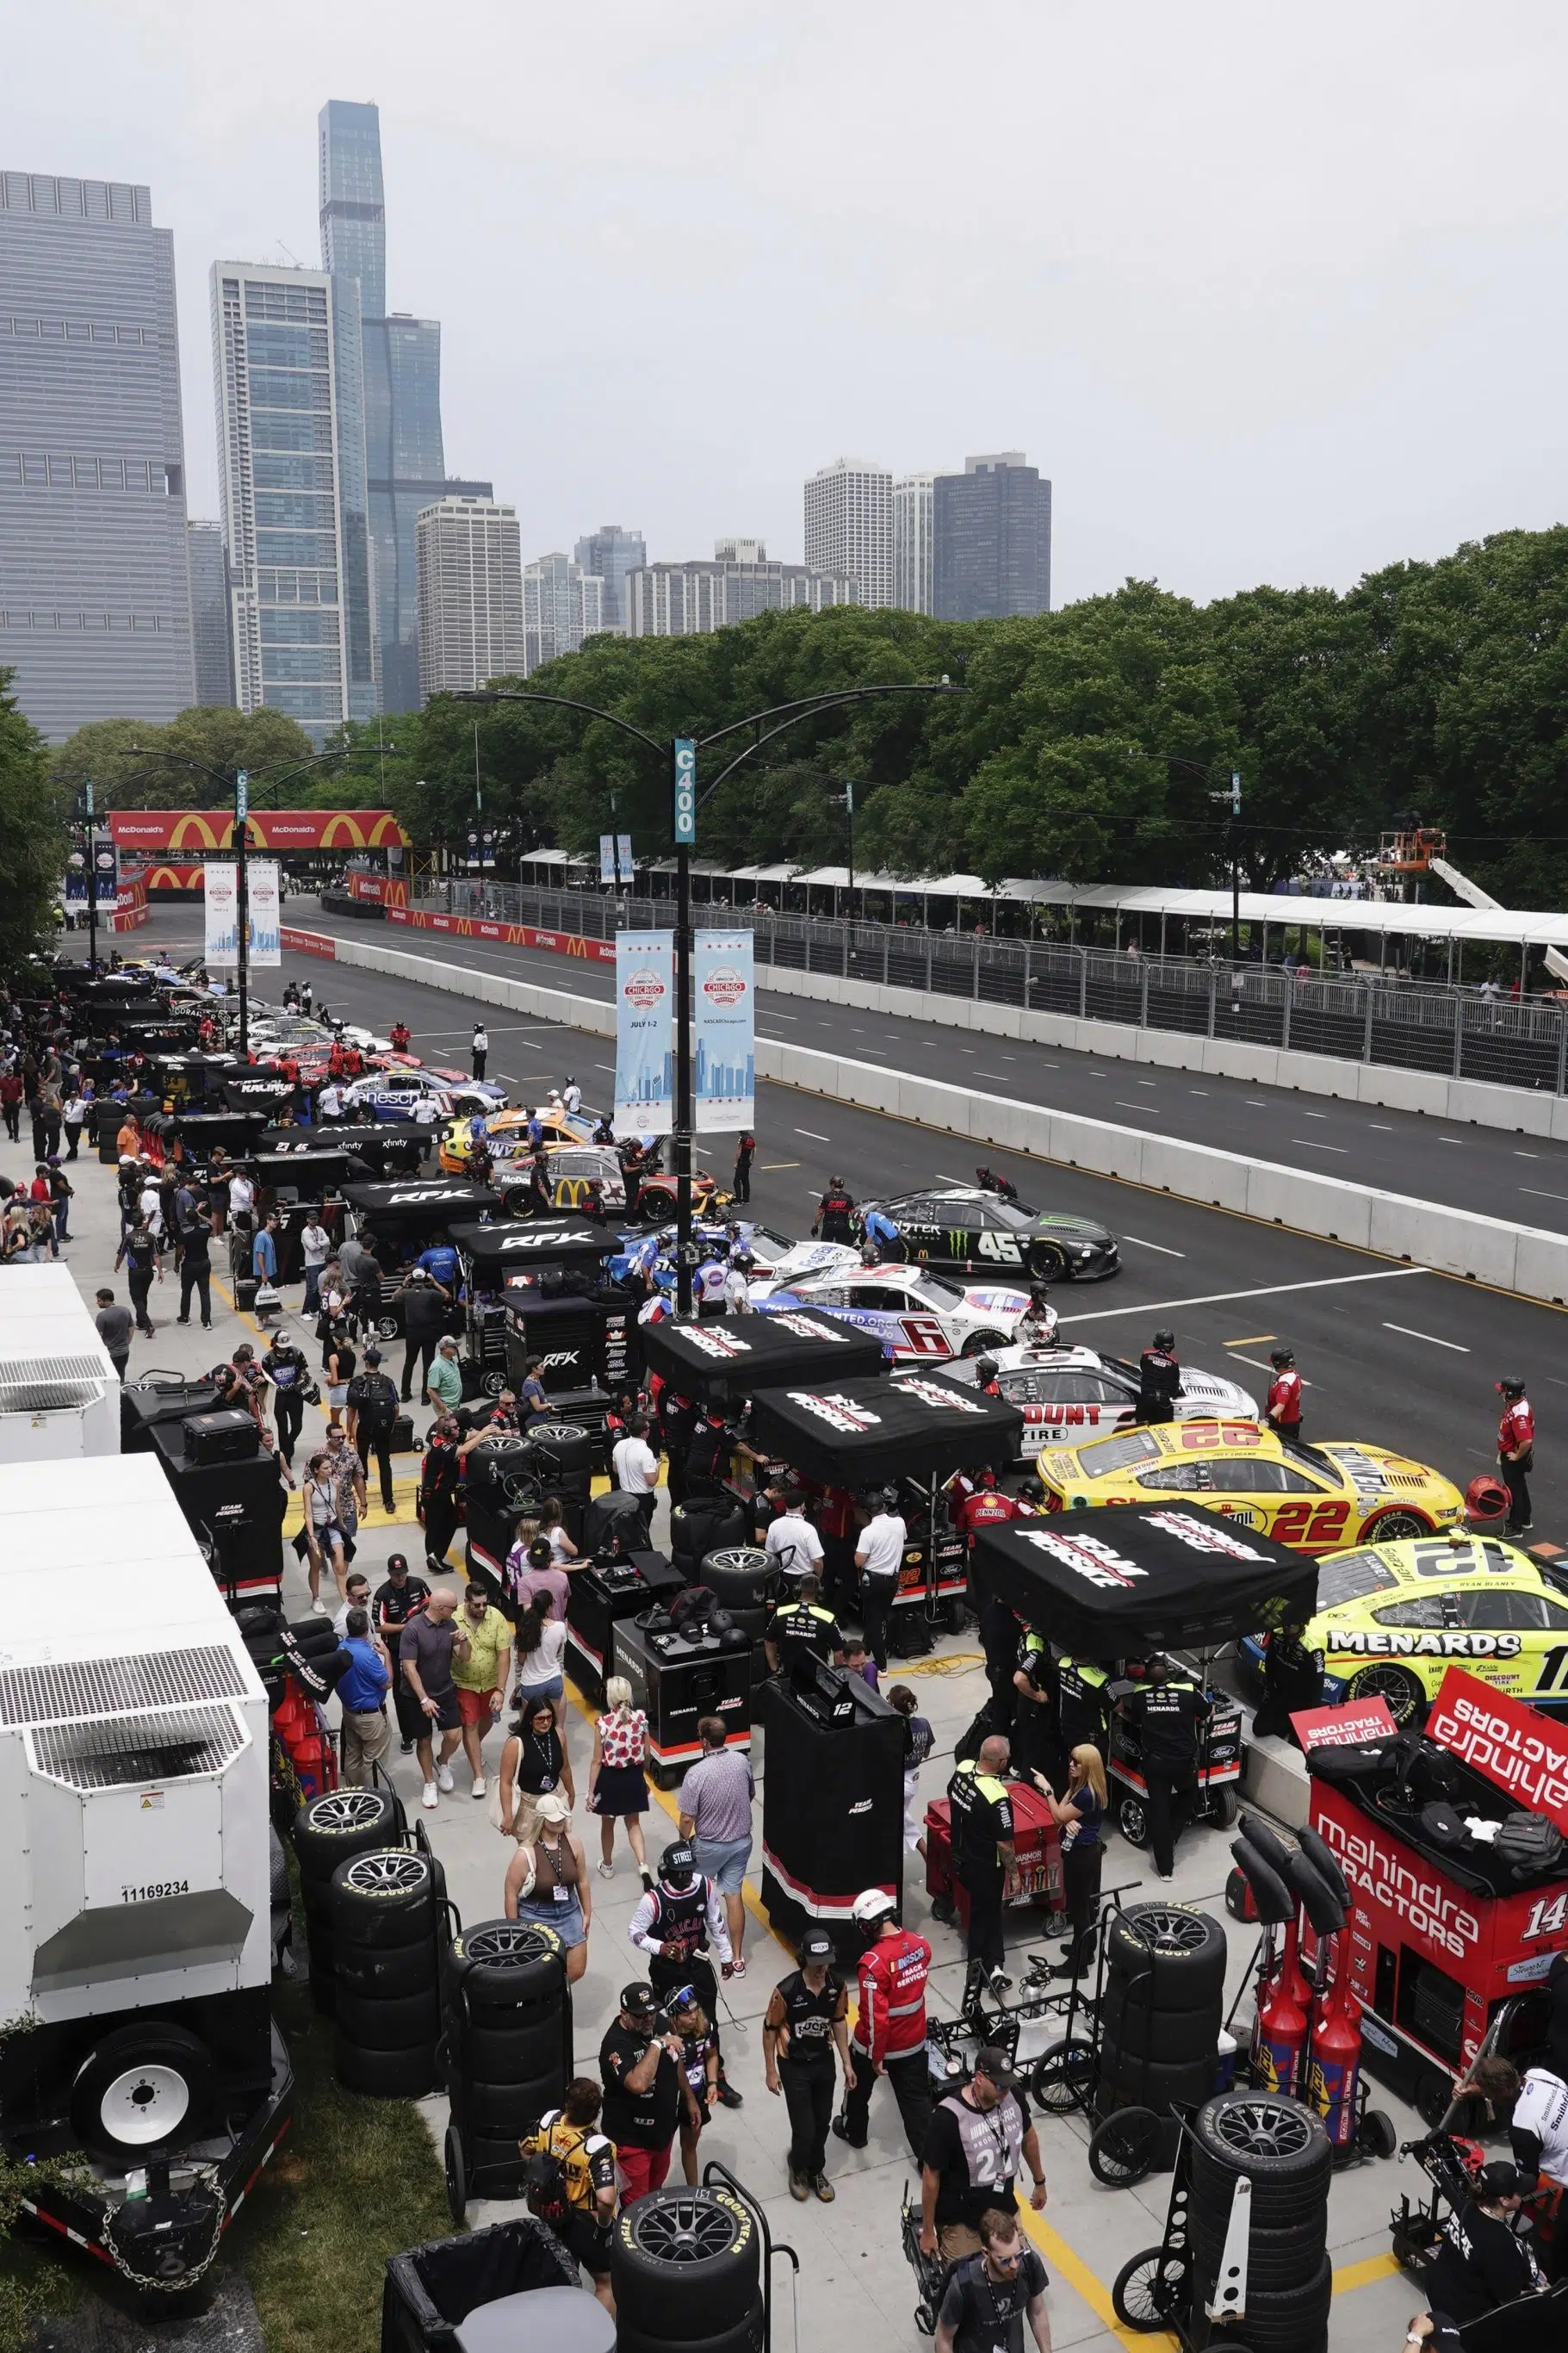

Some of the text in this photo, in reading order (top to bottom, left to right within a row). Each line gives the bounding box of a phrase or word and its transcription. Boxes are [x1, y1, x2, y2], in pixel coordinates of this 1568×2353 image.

[237, 775, 248, 816] C340
[677, 749, 694, 833] C400
[628, 985, 661, 995] CHICAGO
[707, 983, 742, 991] CHICAGO
[358, 1090, 420, 1105] enesch
[337, 1139, 408, 1151] xfinity xfinity
[387, 1189, 474, 1204] RFK
[499, 1230, 595, 1250] RFK
[978, 1232, 1023, 1263] 45
[1081, 1250, 1092, 1258] 45
[907, 1320, 945, 1353] 6
[542, 1350, 580, 1368] RFK
[1023, 1404, 1101, 1425] OUNT
[1021, 1430, 1062, 1441] TIRE
[1181, 1422, 1261, 1450] 22
[215, 1508, 245, 1517] PENSKE
[220, 1503, 242, 1512] TEAM
[975, 1508, 1006, 1518] PENNZOIL
[1269, 1500, 1351, 1543] 22
[941, 1565, 962, 1574] Ford
[785, 1630, 816, 1638] MENARDS
[1327, 1630, 1522, 1658] MENARDS
[615, 1645, 645, 1679] MENARDS
[305, 1665, 327, 1686] TEAM
[1323, 1679, 1339, 1692] Boy
[716, 1701, 744, 1712] PENSKE
[721, 1697, 742, 1707] TEAM
[833, 1702, 852, 1717] 12
[669, 1706, 697, 1717] MENARDS
[1398, 1700, 1416, 1723] EAGLE
[1212, 1721, 1236, 1731] TEAM
[1307, 1716, 1384, 1739] TRACTORS
[1212, 1746, 1235, 1758] Ford
[1433, 1713, 1568, 1810] ahindra
[330, 1785, 365, 1796] EAGLE
[307, 1819, 380, 1835] GOODYEAR
[1317, 1812, 1478, 1944] mahindra
[121, 1879, 189, 1903] 11169234
[341, 1881, 414, 1897] GOODYEAR
[1166, 1901, 1204, 1915] EAGLE
[1329, 1847, 1465, 1959] TRACTORS
[1519, 1891, 1568, 1942] 14
[663, 1916, 705, 1942] CHICA
[532, 1922, 561, 1963] GOODYER
[898, 1946, 926, 1969] NASCAR
[896, 1968, 928, 1989] SERVICES
[902, 1962, 923, 1978] TRACK
[563, 2161, 582, 2179] ALT
[716, 2192, 752, 2255] GOODYEAR
[620, 2216, 639, 2251] EAGLE
